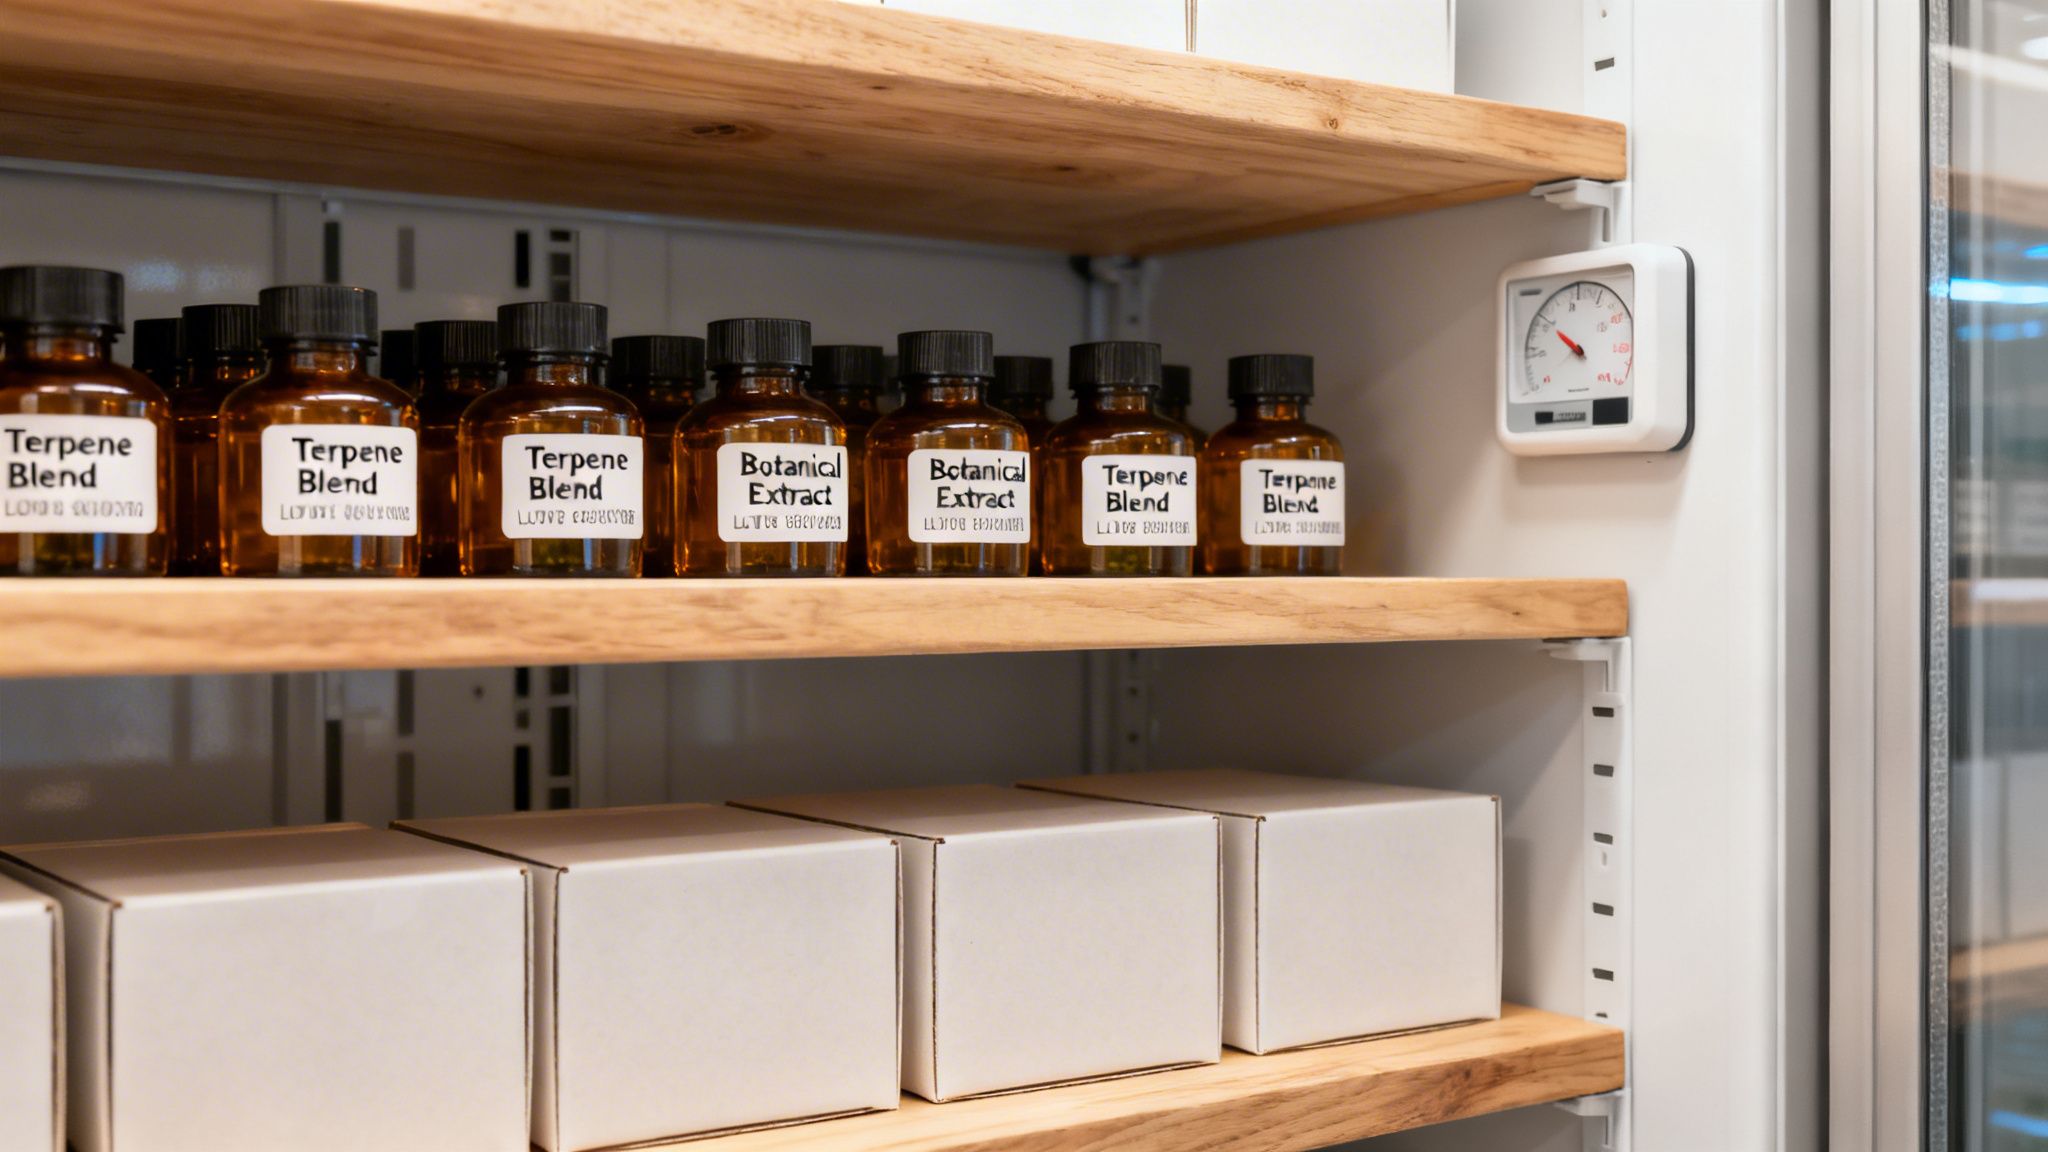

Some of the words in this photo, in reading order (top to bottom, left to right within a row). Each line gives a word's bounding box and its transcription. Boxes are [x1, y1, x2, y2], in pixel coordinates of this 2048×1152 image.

[5, 429, 132, 460] Terpene
[292, 437, 404, 469] Terpene
[8, 462, 97, 489] Blend
[525, 446, 629, 478] Terpene
[298, 469, 378, 496] Blend
[530, 476, 602, 501] Blend
[749, 482, 833, 506] Extract
[937, 486, 1015, 509] Extract
[1107, 490, 1169, 513] Blend
